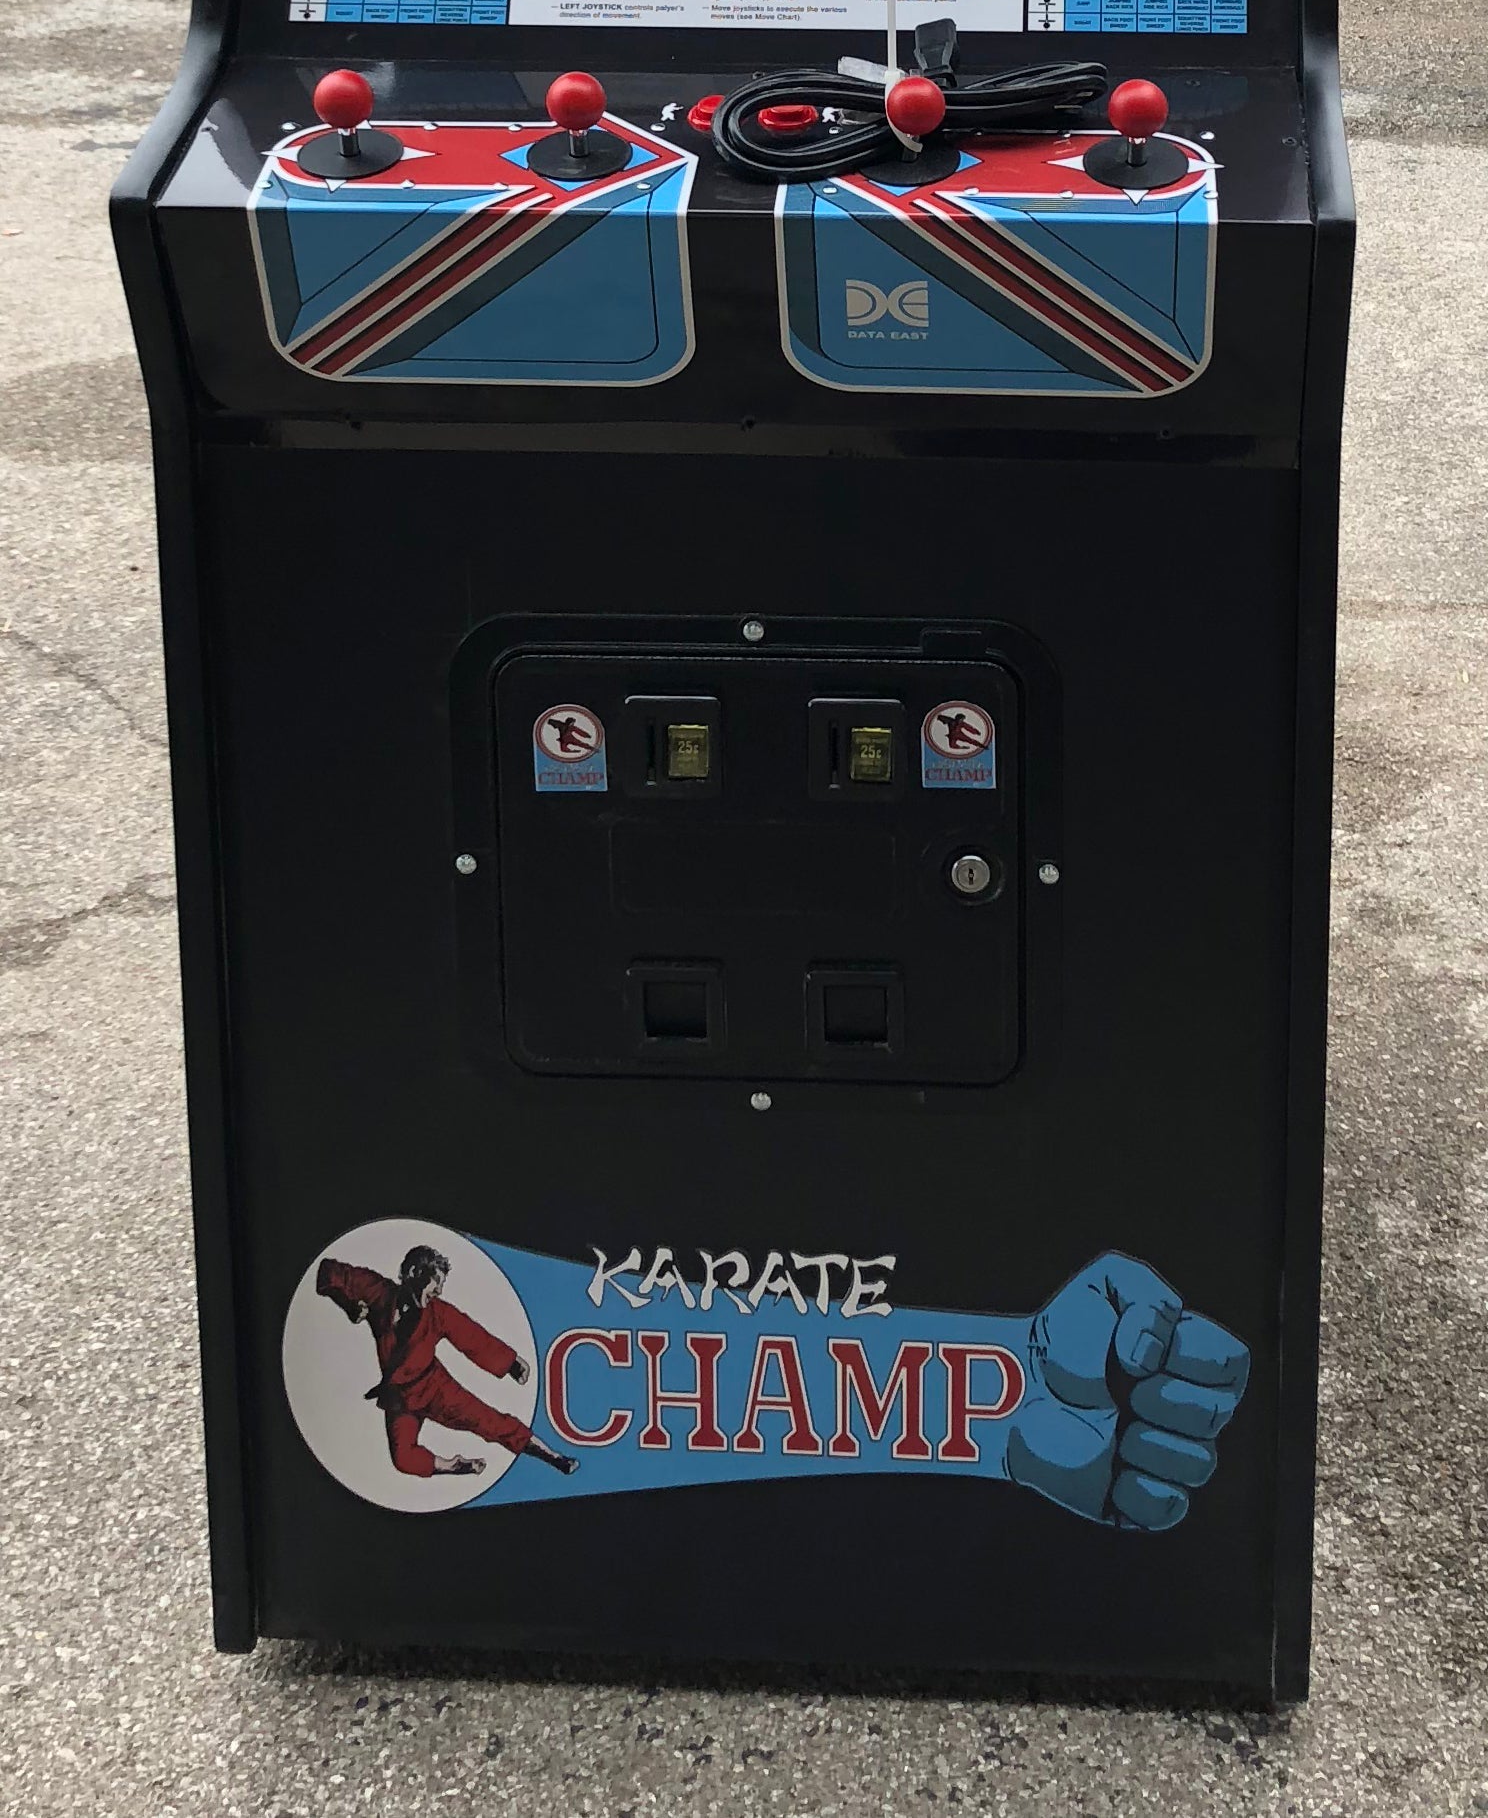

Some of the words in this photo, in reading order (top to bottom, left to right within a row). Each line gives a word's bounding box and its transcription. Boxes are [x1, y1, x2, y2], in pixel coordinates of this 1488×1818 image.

[847, 330, 885, 339] DATA
[890, 331, 929, 340] EAST
[587, 1246, 897, 1319] KARATE
[545, 1328, 1026, 1463] CHAMP
[1026, 1345, 1048, 1359] TM
